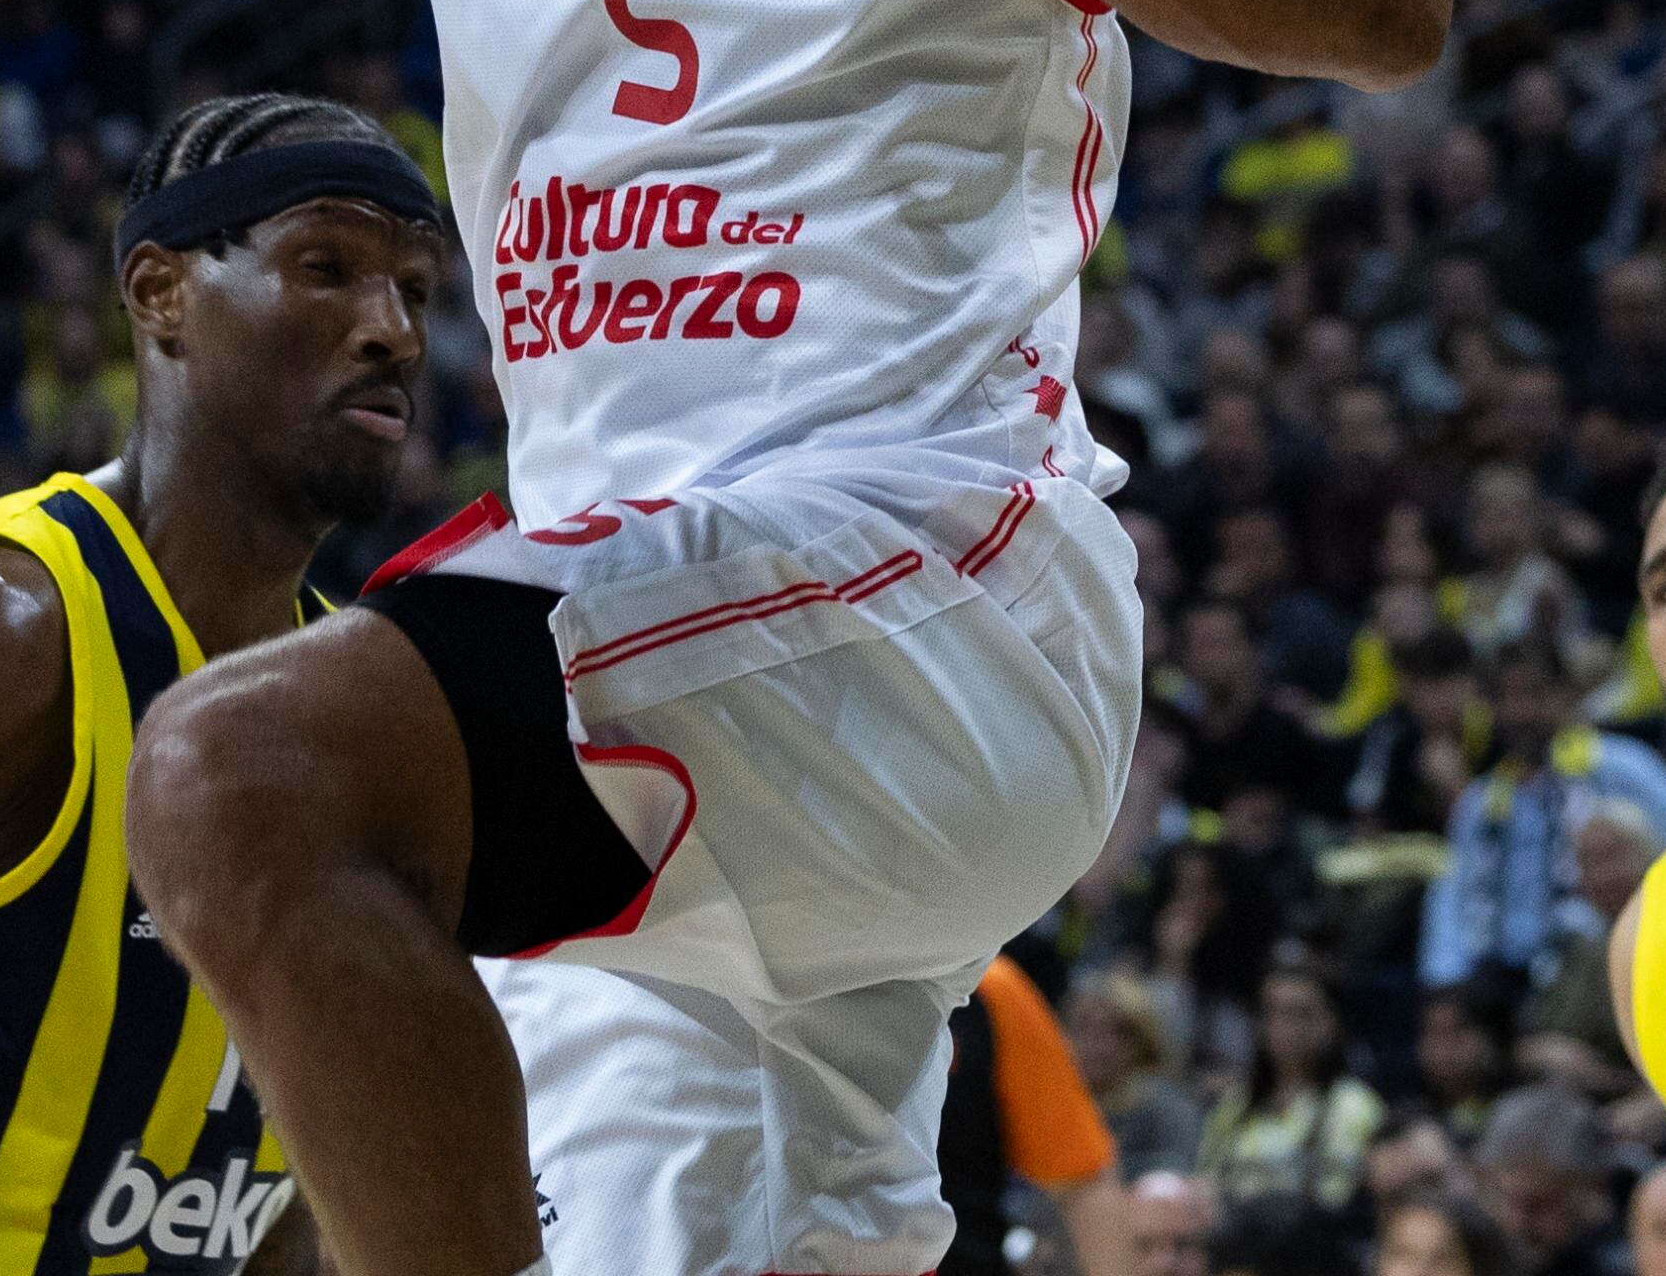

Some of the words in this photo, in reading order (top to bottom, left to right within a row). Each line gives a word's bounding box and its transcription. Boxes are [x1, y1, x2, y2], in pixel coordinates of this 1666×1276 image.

[495, 175, 721, 265] Cultura
[720, 211, 805, 245] del
[495, 264, 802, 363] Esfuerzo
